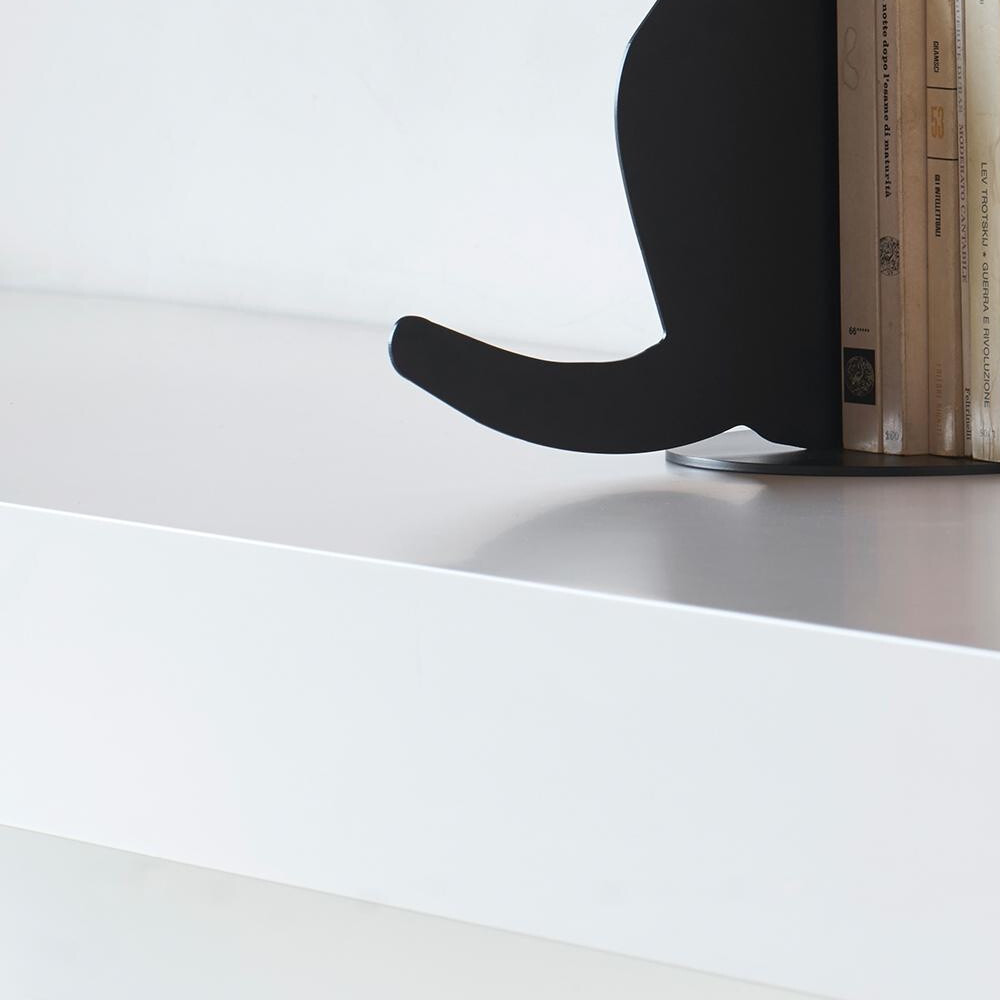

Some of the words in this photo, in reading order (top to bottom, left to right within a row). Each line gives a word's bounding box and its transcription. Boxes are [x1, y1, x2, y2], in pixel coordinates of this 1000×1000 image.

[881, 40, 890, 71] dopo
[883, 124, 891, 137] di
[884, 139, 892, 199] maturità
[958, 124, 966, 202] MODERATO
[980, 162, 988, 186] LEV
[960, 205, 968, 284] CANTABILE
[981, 189, 989, 247] TROTSKIJ
[982, 263, 990, 313] GUERRA
[983, 317, 990, 325] E
[983, 328, 991, 408] RIVOLUZIONE
